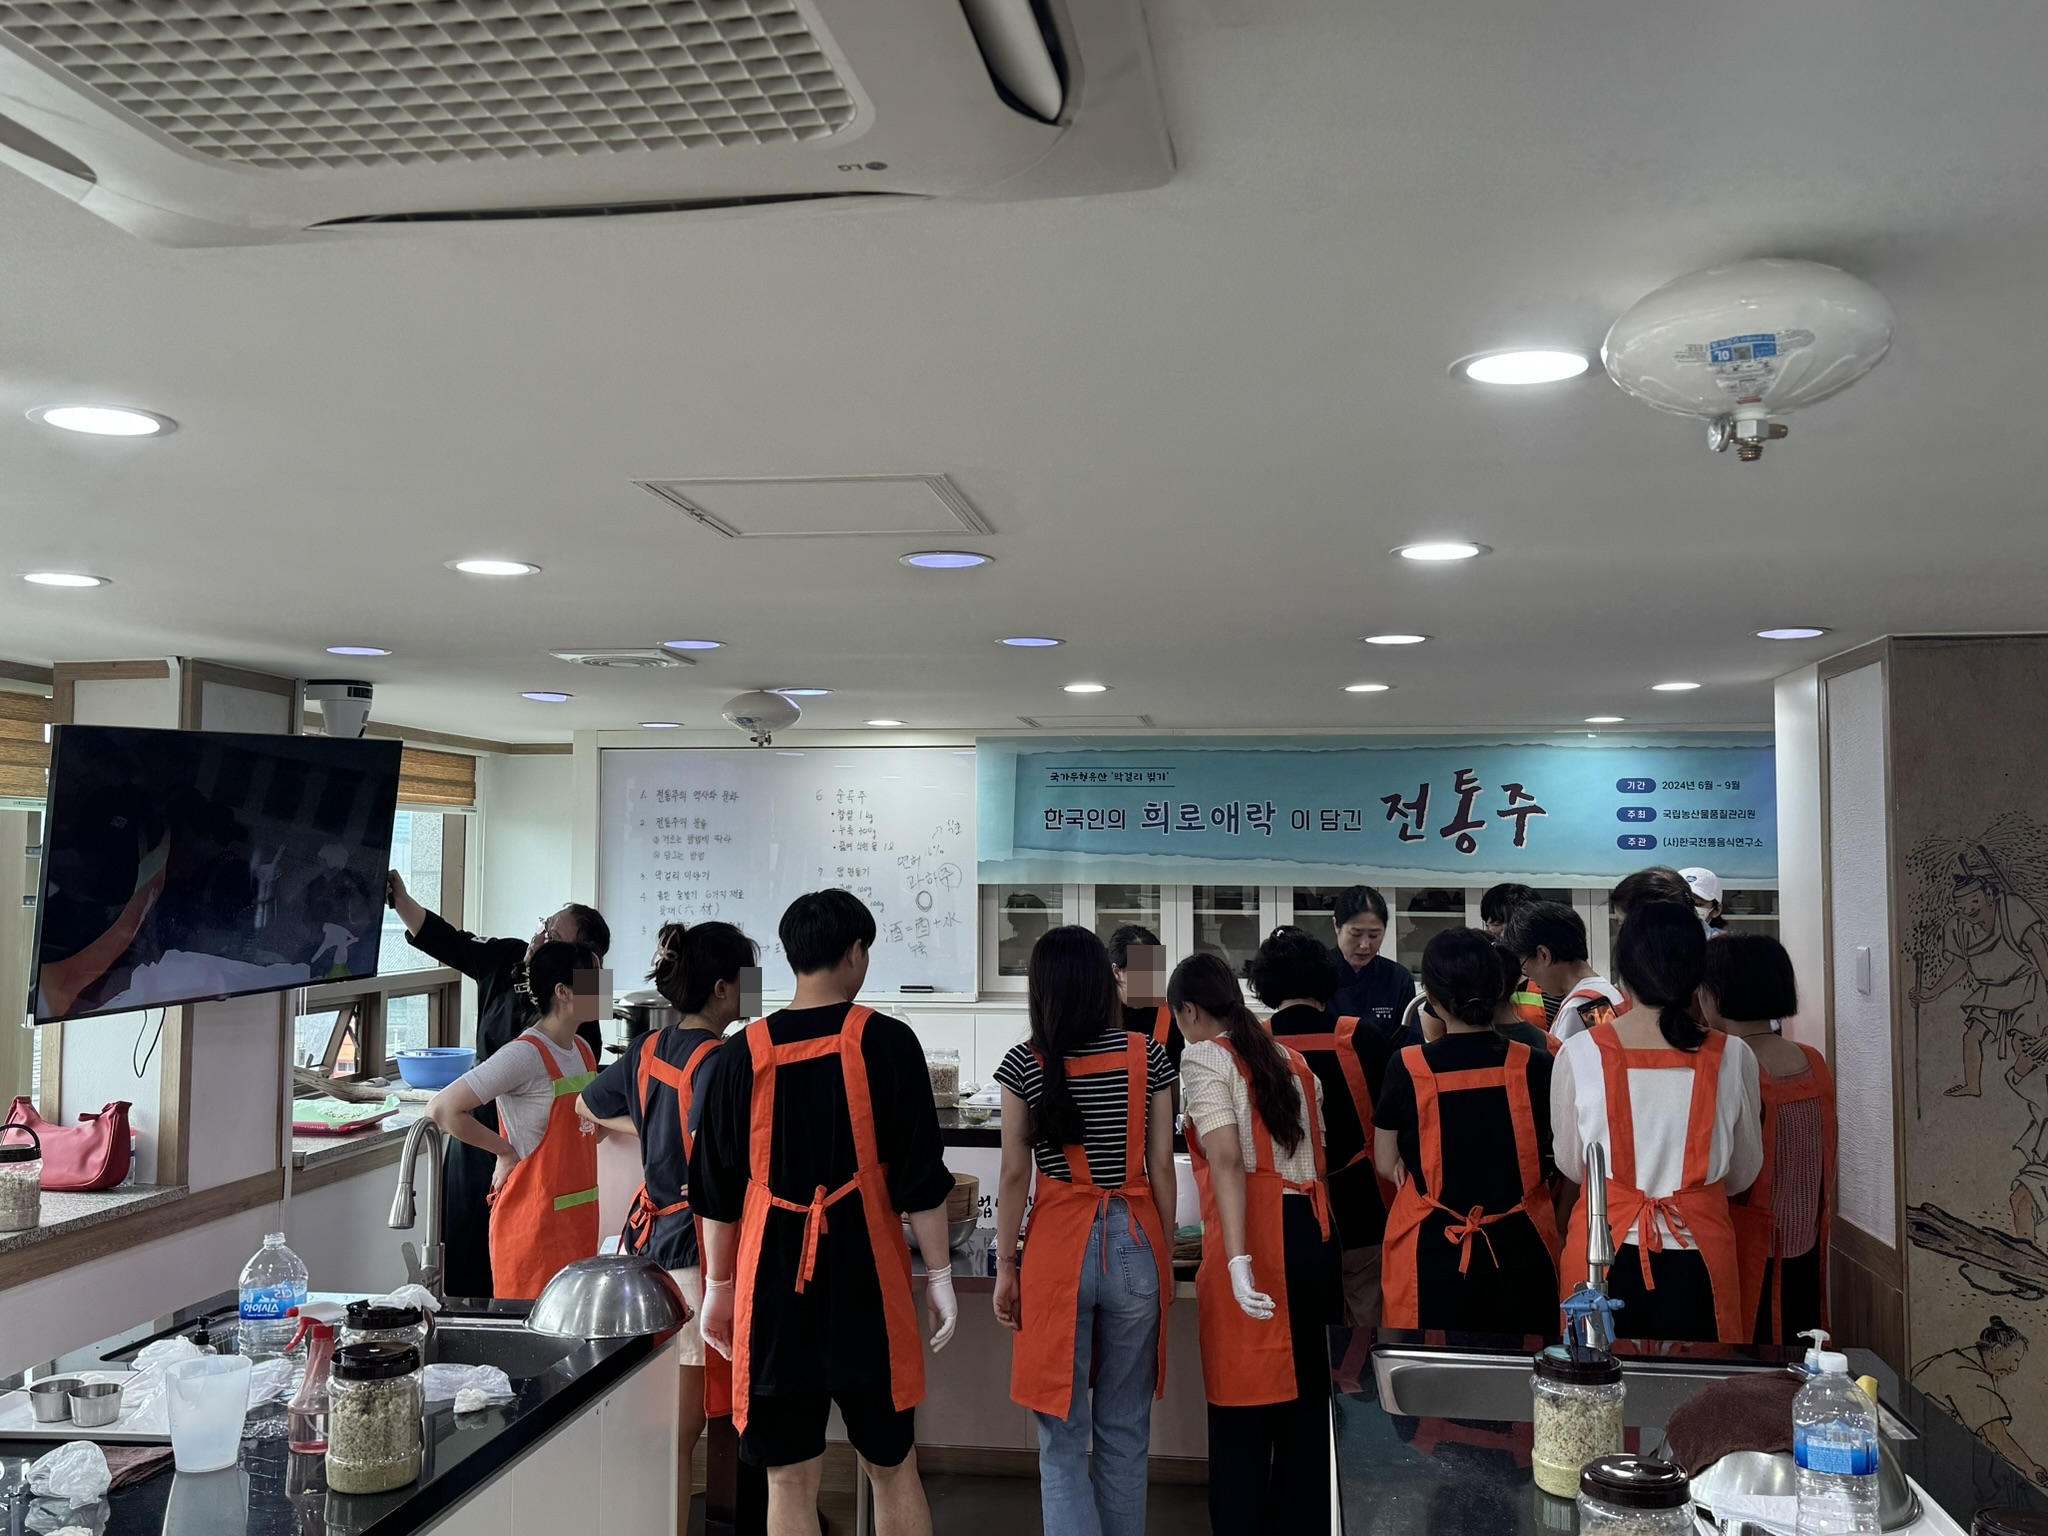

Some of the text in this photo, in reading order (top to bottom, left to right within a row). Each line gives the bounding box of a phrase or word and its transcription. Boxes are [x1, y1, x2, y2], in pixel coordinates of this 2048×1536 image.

[837, 164, 863, 172] LG
[1050, 772, 1107, 783] 국가무형유산
[1627, 781, 1646, 791] 기간
[1662, 780, 1695, 791] 2024년
[1698, 780, 1713, 791] 6월
[1725, 780, 1740, 791] 9월
[656, 789, 687, 803] 전통주의
[1044, 768, 1549, 856] 한국인의 희로애락 이 담긴 전통주
[1627, 809, 1647, 820] 주최
[1662, 809, 1756, 820] 국립농산물품질관리원
[656, 817, 687, 829] 전통주의
[1627, 837, 1647, 847] 주관
[1662, 837, 1763, 849] (사)한국전통음식연구소
